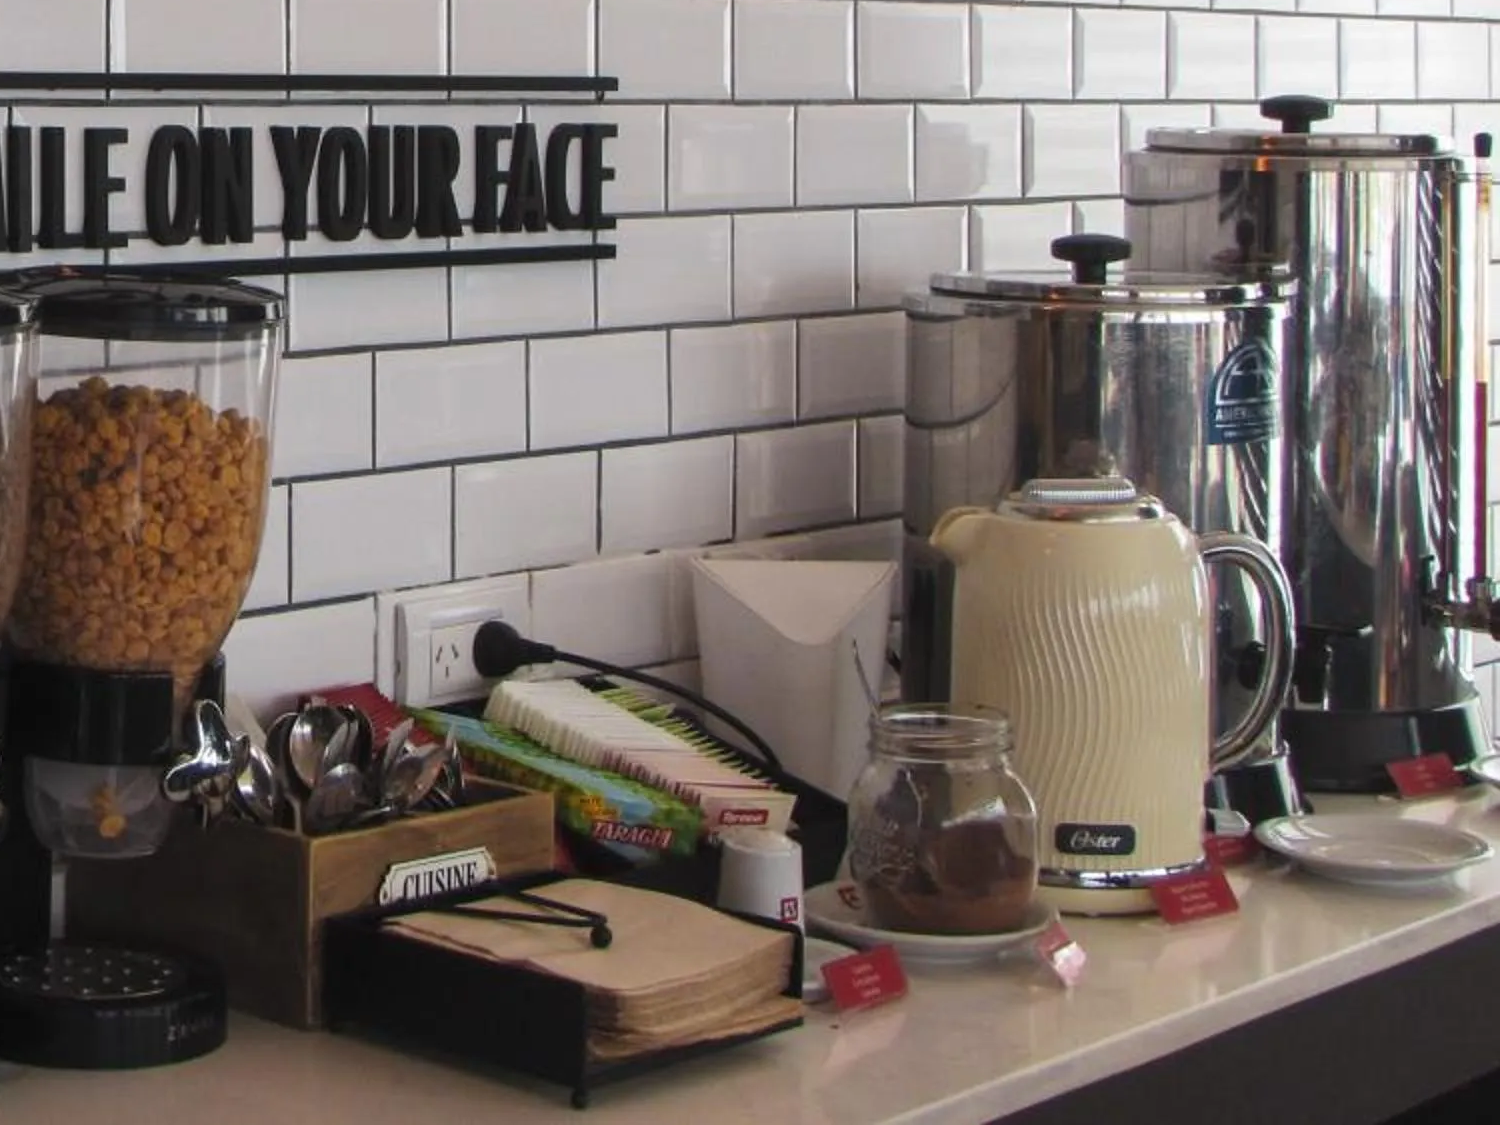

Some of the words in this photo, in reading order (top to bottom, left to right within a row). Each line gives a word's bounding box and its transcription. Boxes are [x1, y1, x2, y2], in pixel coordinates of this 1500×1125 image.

[145, 125, 254, 245] ON
[270, 123, 463, 242] YOUR
[473, 122, 618, 233] FACE
[403, 862, 477, 899] CUISINE
